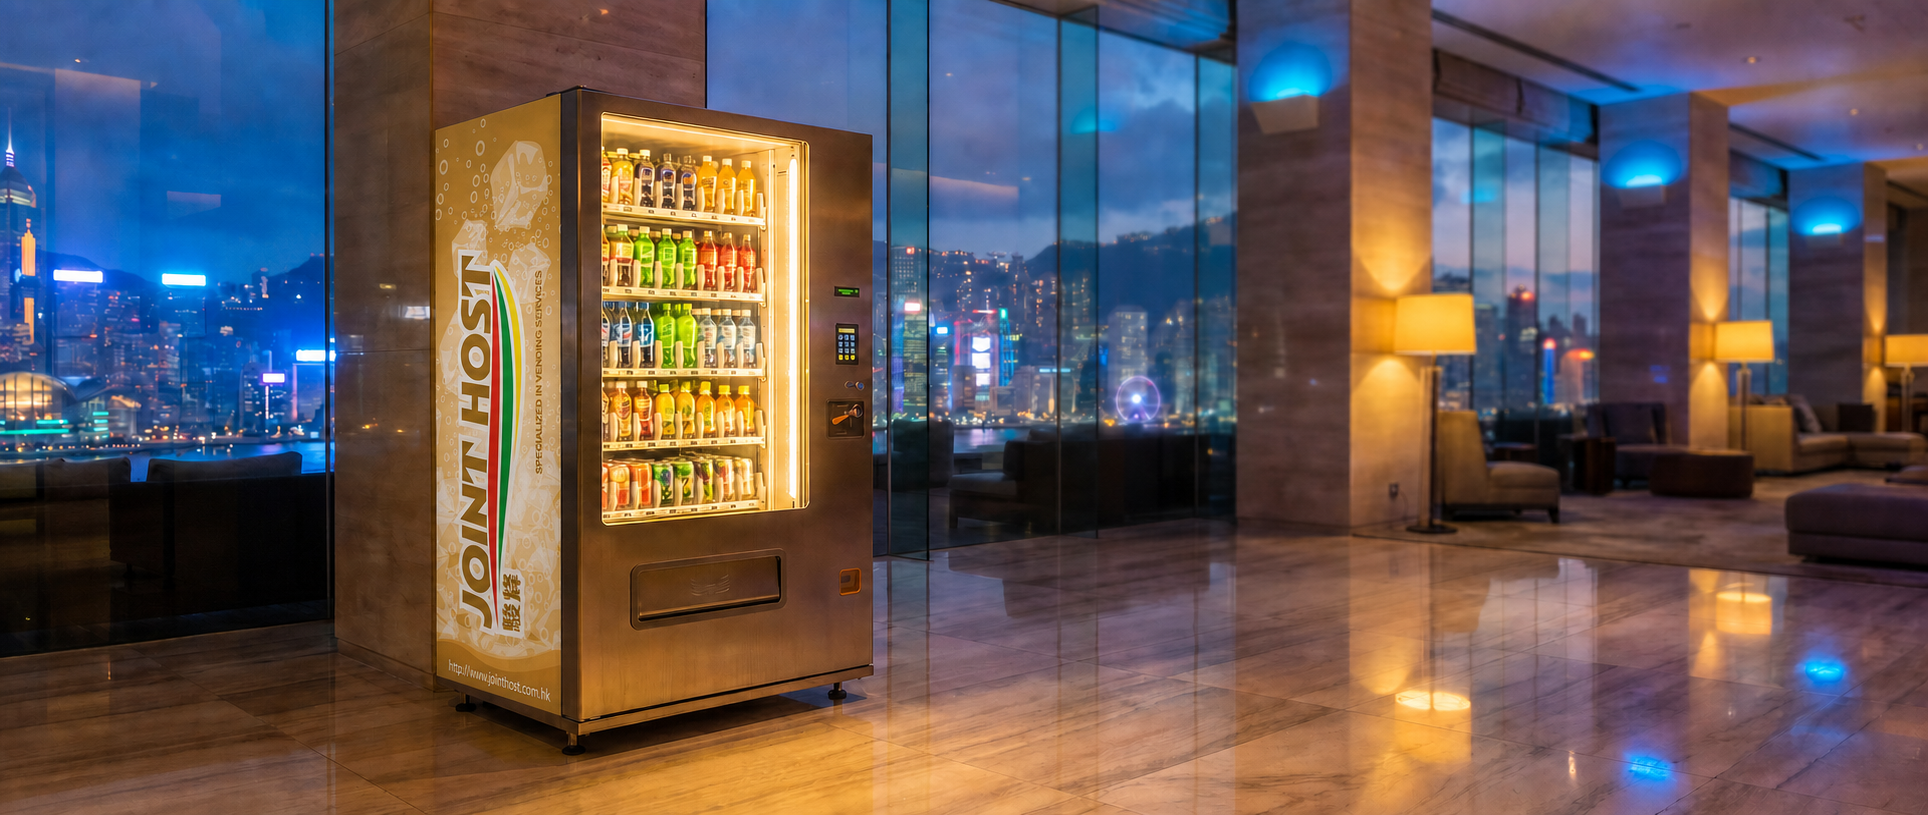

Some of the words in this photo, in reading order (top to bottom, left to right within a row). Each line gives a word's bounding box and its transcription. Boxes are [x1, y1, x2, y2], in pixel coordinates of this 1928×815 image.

[461, 255, 491, 426] HOST
[535, 330, 543, 383] VENDING
[535, 385, 543, 396] IN
[535, 399, 543, 475] SPECIALIZED
[461, 440, 493, 629] JOINT
[448, 659, 551, 702] http://www.jointhost.com.hk
